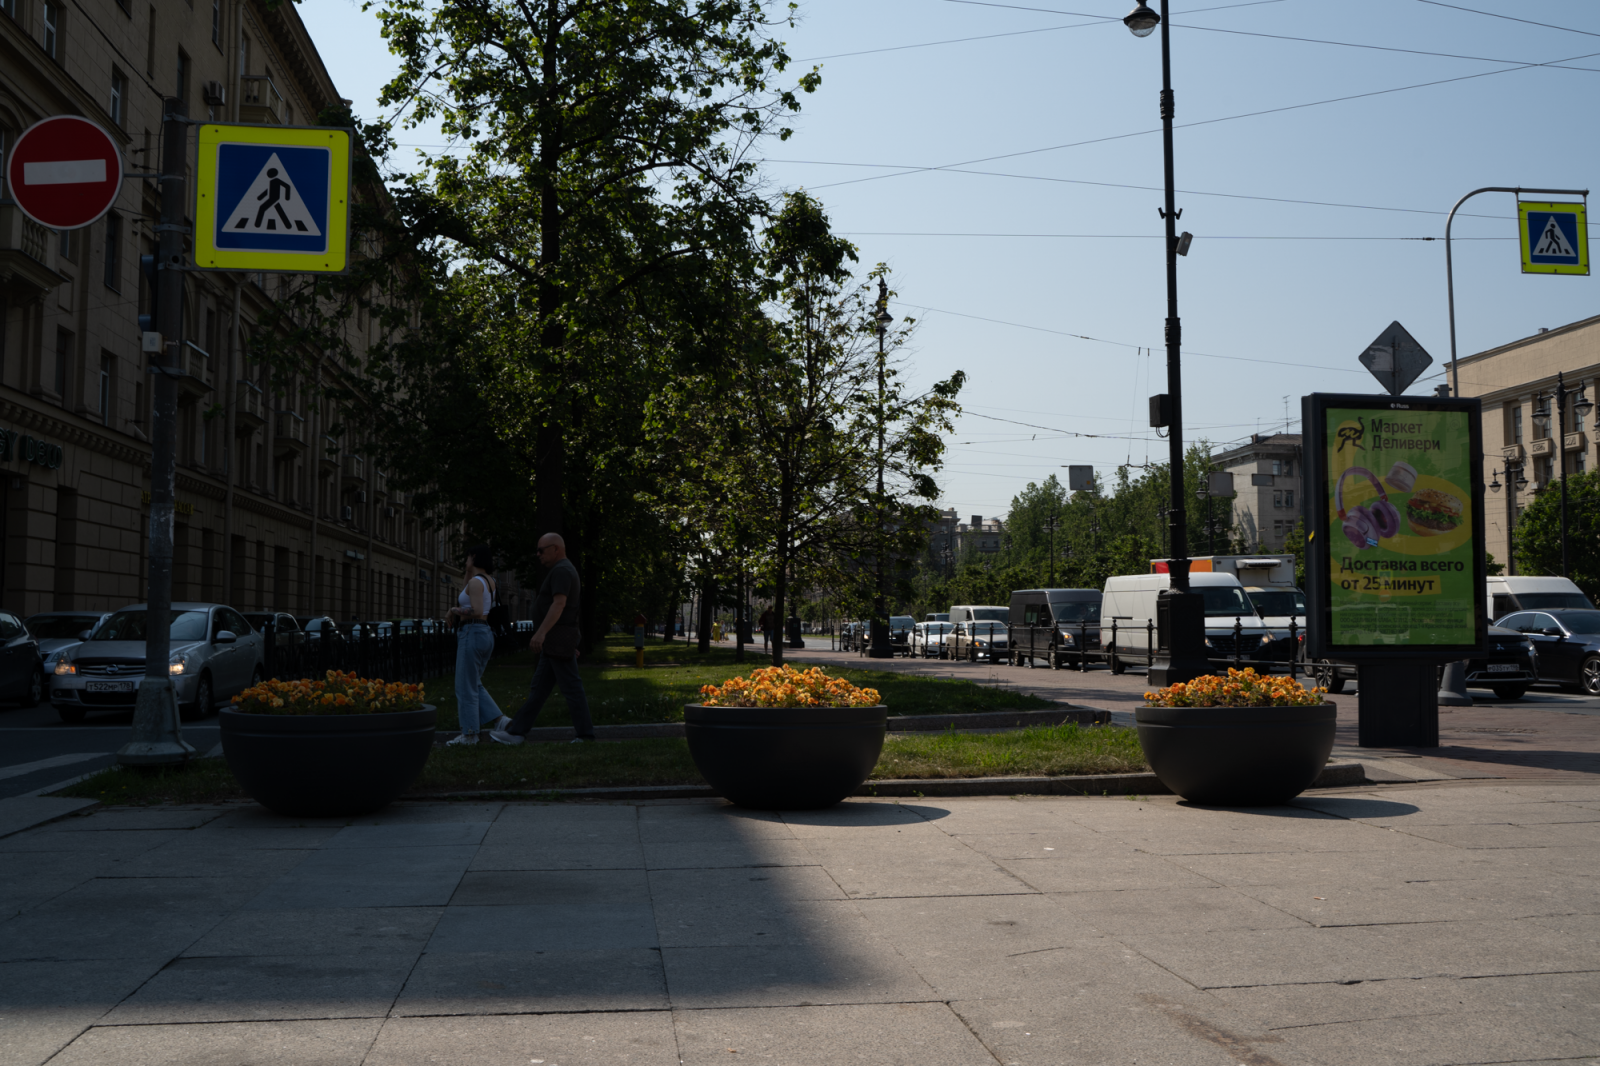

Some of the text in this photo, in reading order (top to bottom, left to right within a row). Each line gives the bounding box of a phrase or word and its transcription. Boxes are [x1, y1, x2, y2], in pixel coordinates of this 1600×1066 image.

[1371, 419, 1423, 436] Маркет
[1372, 435, 1441, 452] Деливери
[1340, 557, 1464, 573] Доставка всего
[1341, 576, 1435, 594] от 25 минут
